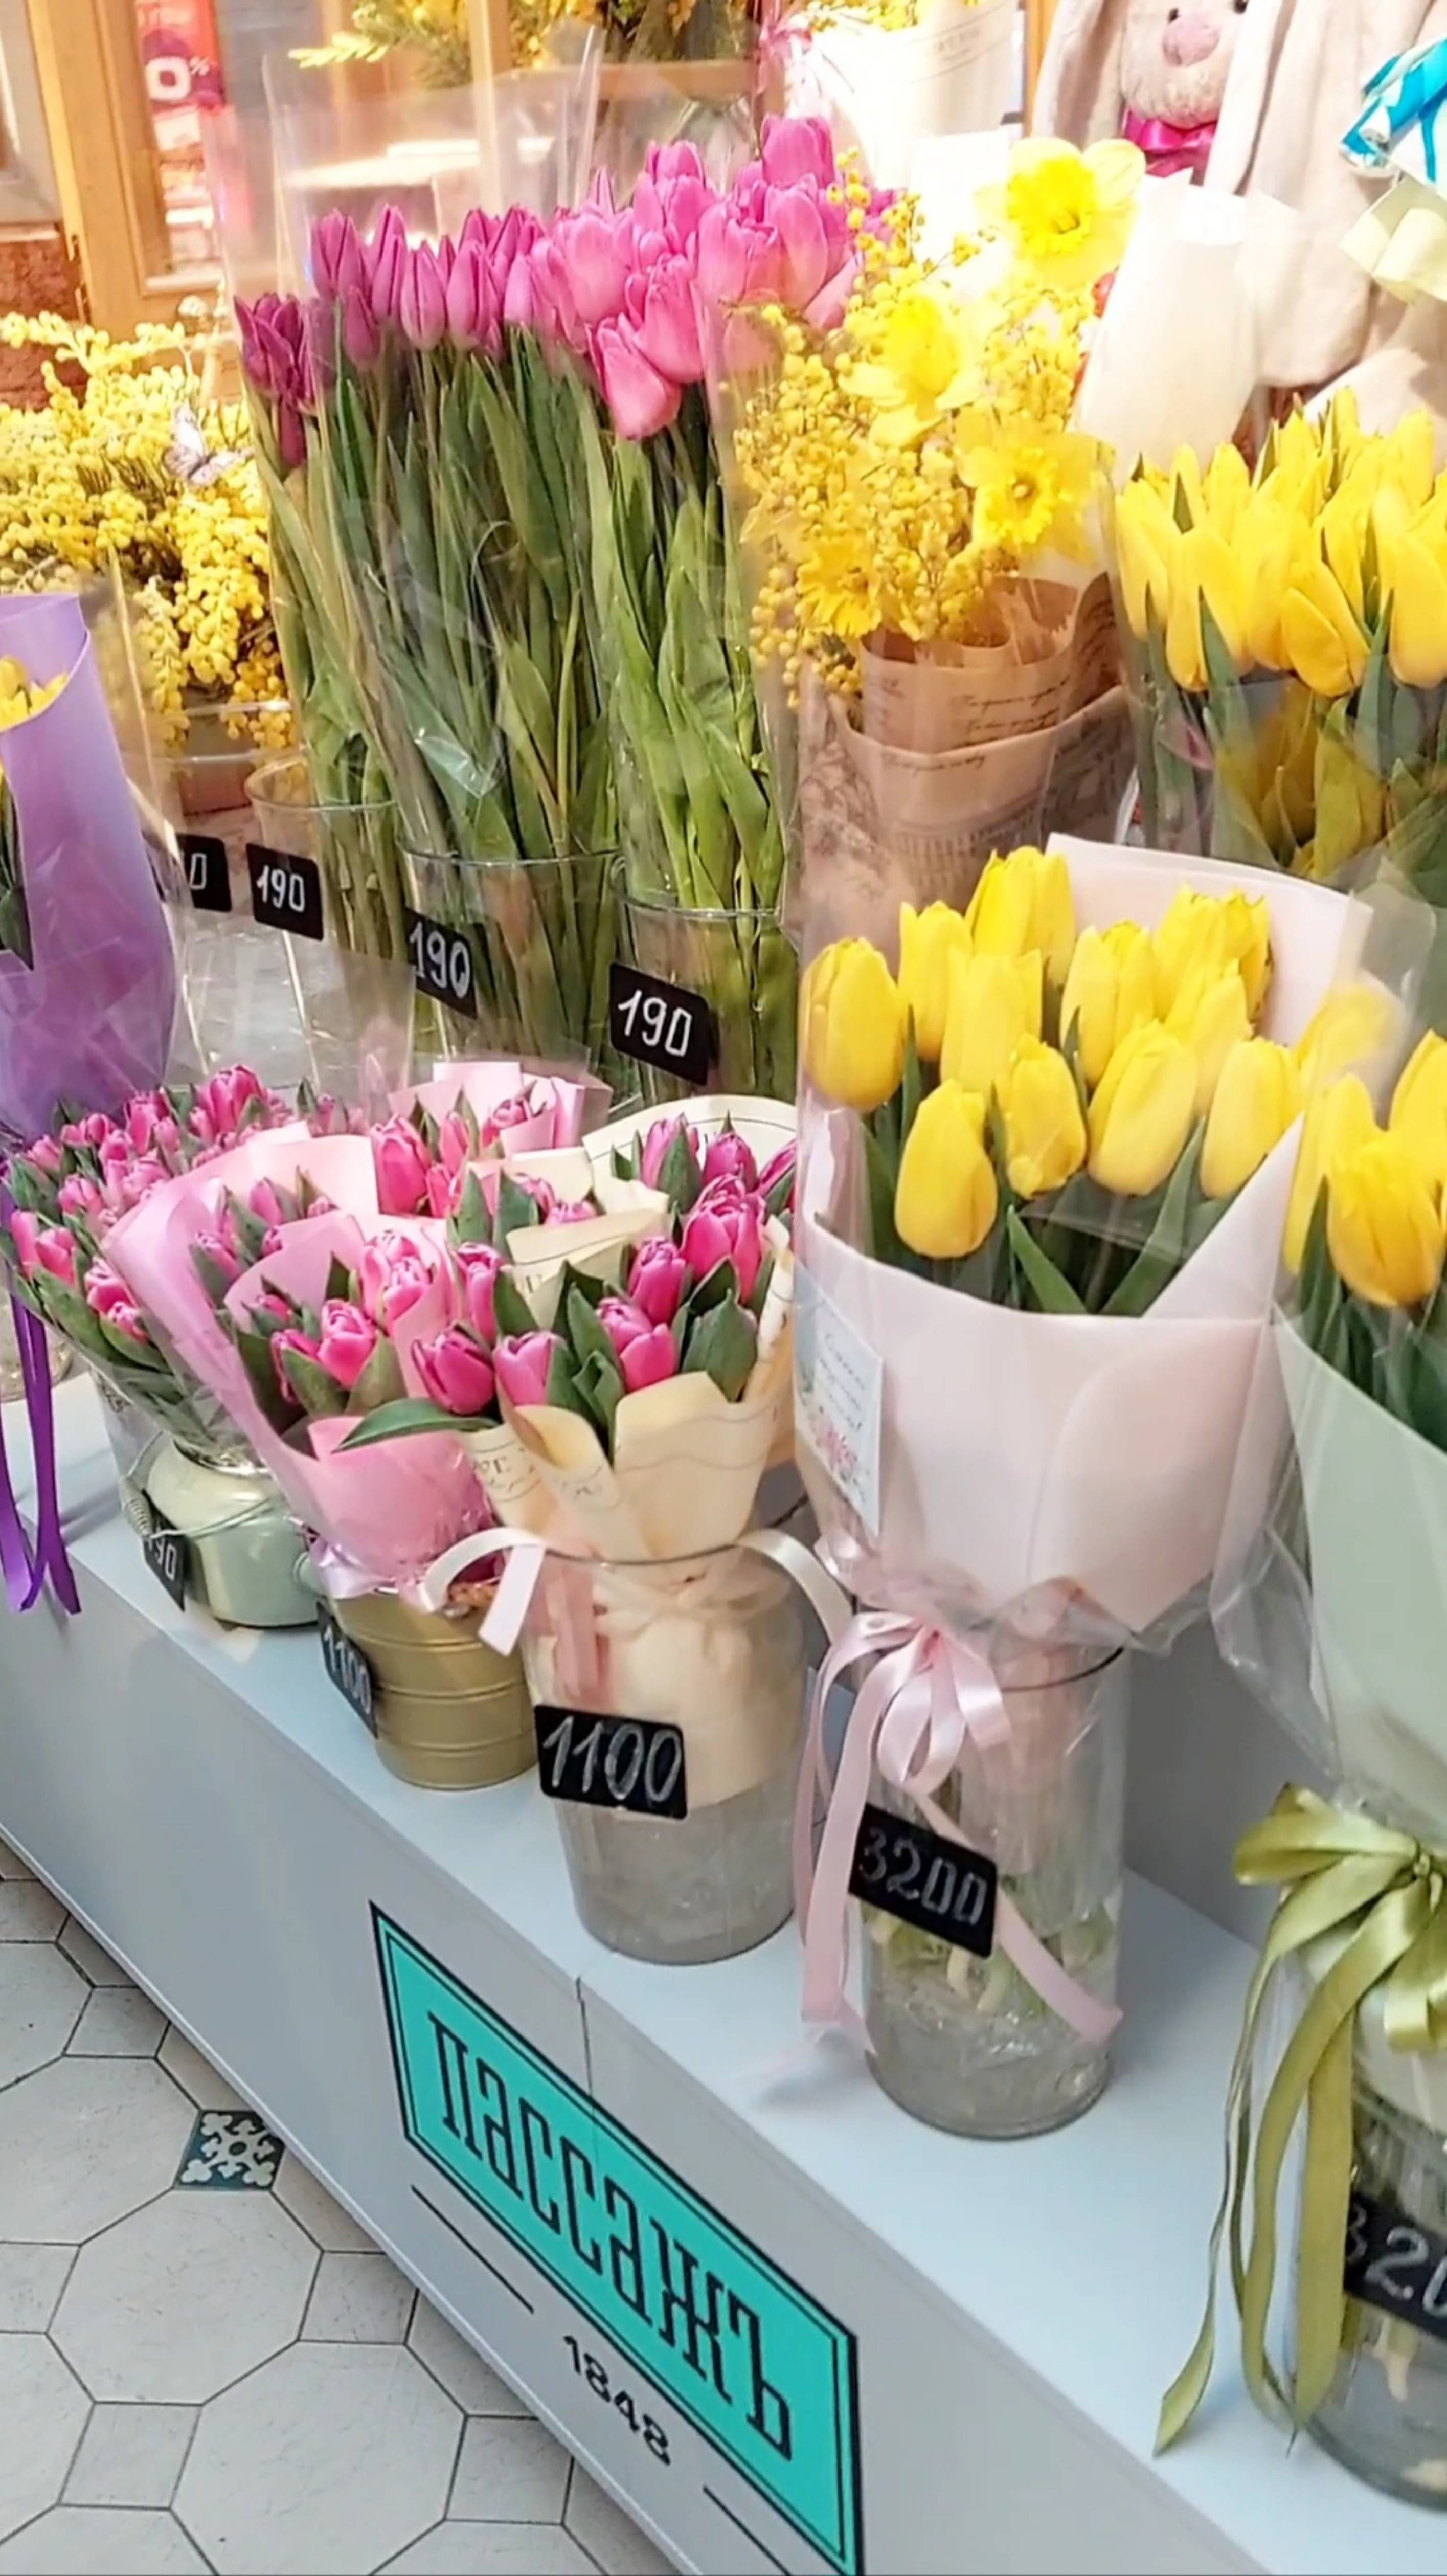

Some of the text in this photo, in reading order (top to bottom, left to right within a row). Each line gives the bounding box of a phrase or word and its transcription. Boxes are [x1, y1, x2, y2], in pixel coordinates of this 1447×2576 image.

[144, 56, 211, 101] 0%
[257, 865, 306, 912] 190
[410, 922, 470, 998] 190
[618, 989, 692, 1057] 190
[324, 1625, 372, 1714] 1100
[542, 1715, 681, 1802] 1100
[858, 1827, 988, 1926] 3200
[562, 2335, 672, 2466] 1848
